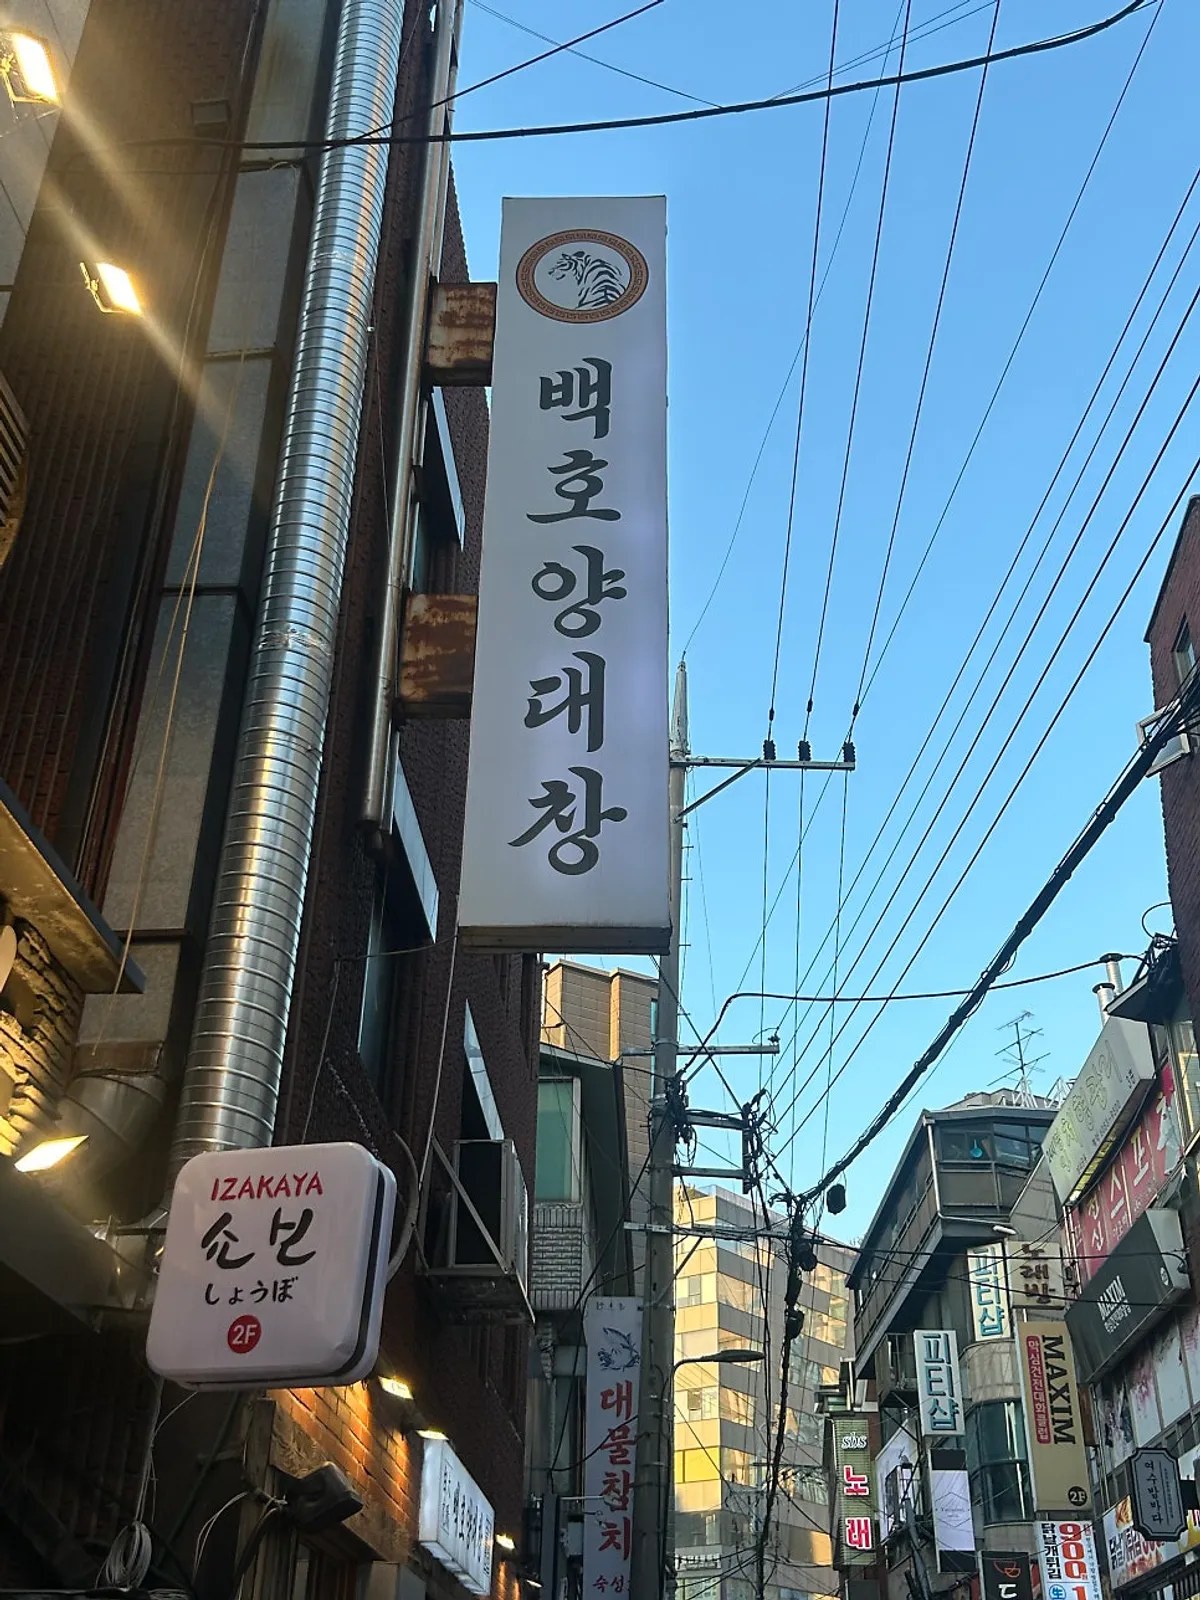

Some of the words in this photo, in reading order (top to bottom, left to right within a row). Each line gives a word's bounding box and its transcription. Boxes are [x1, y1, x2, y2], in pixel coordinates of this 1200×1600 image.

[507, 357, 628, 876] 백호양대창
[211, 1172, 324, 1201] IZAKAYA
[201, 1207, 317, 1270] 소보
[205, 1276, 299, 1306] しょうぼ
[973, 1246, 1005, 1337] 피터샵
[1020, 1243, 1056, 1304] 노래방
[232, 1324, 258, 1346] 2F
[923, 1333, 960, 1431] 피터샵
[1041, 1335, 1076, 1445] MAXIM
[599, 1380, 635, 1561] 대물참치
[841, 1431, 868, 1450] sbs
[1069, 1490, 1087, 1504] 2F
[592, 1574, 631, 1594] 속성
